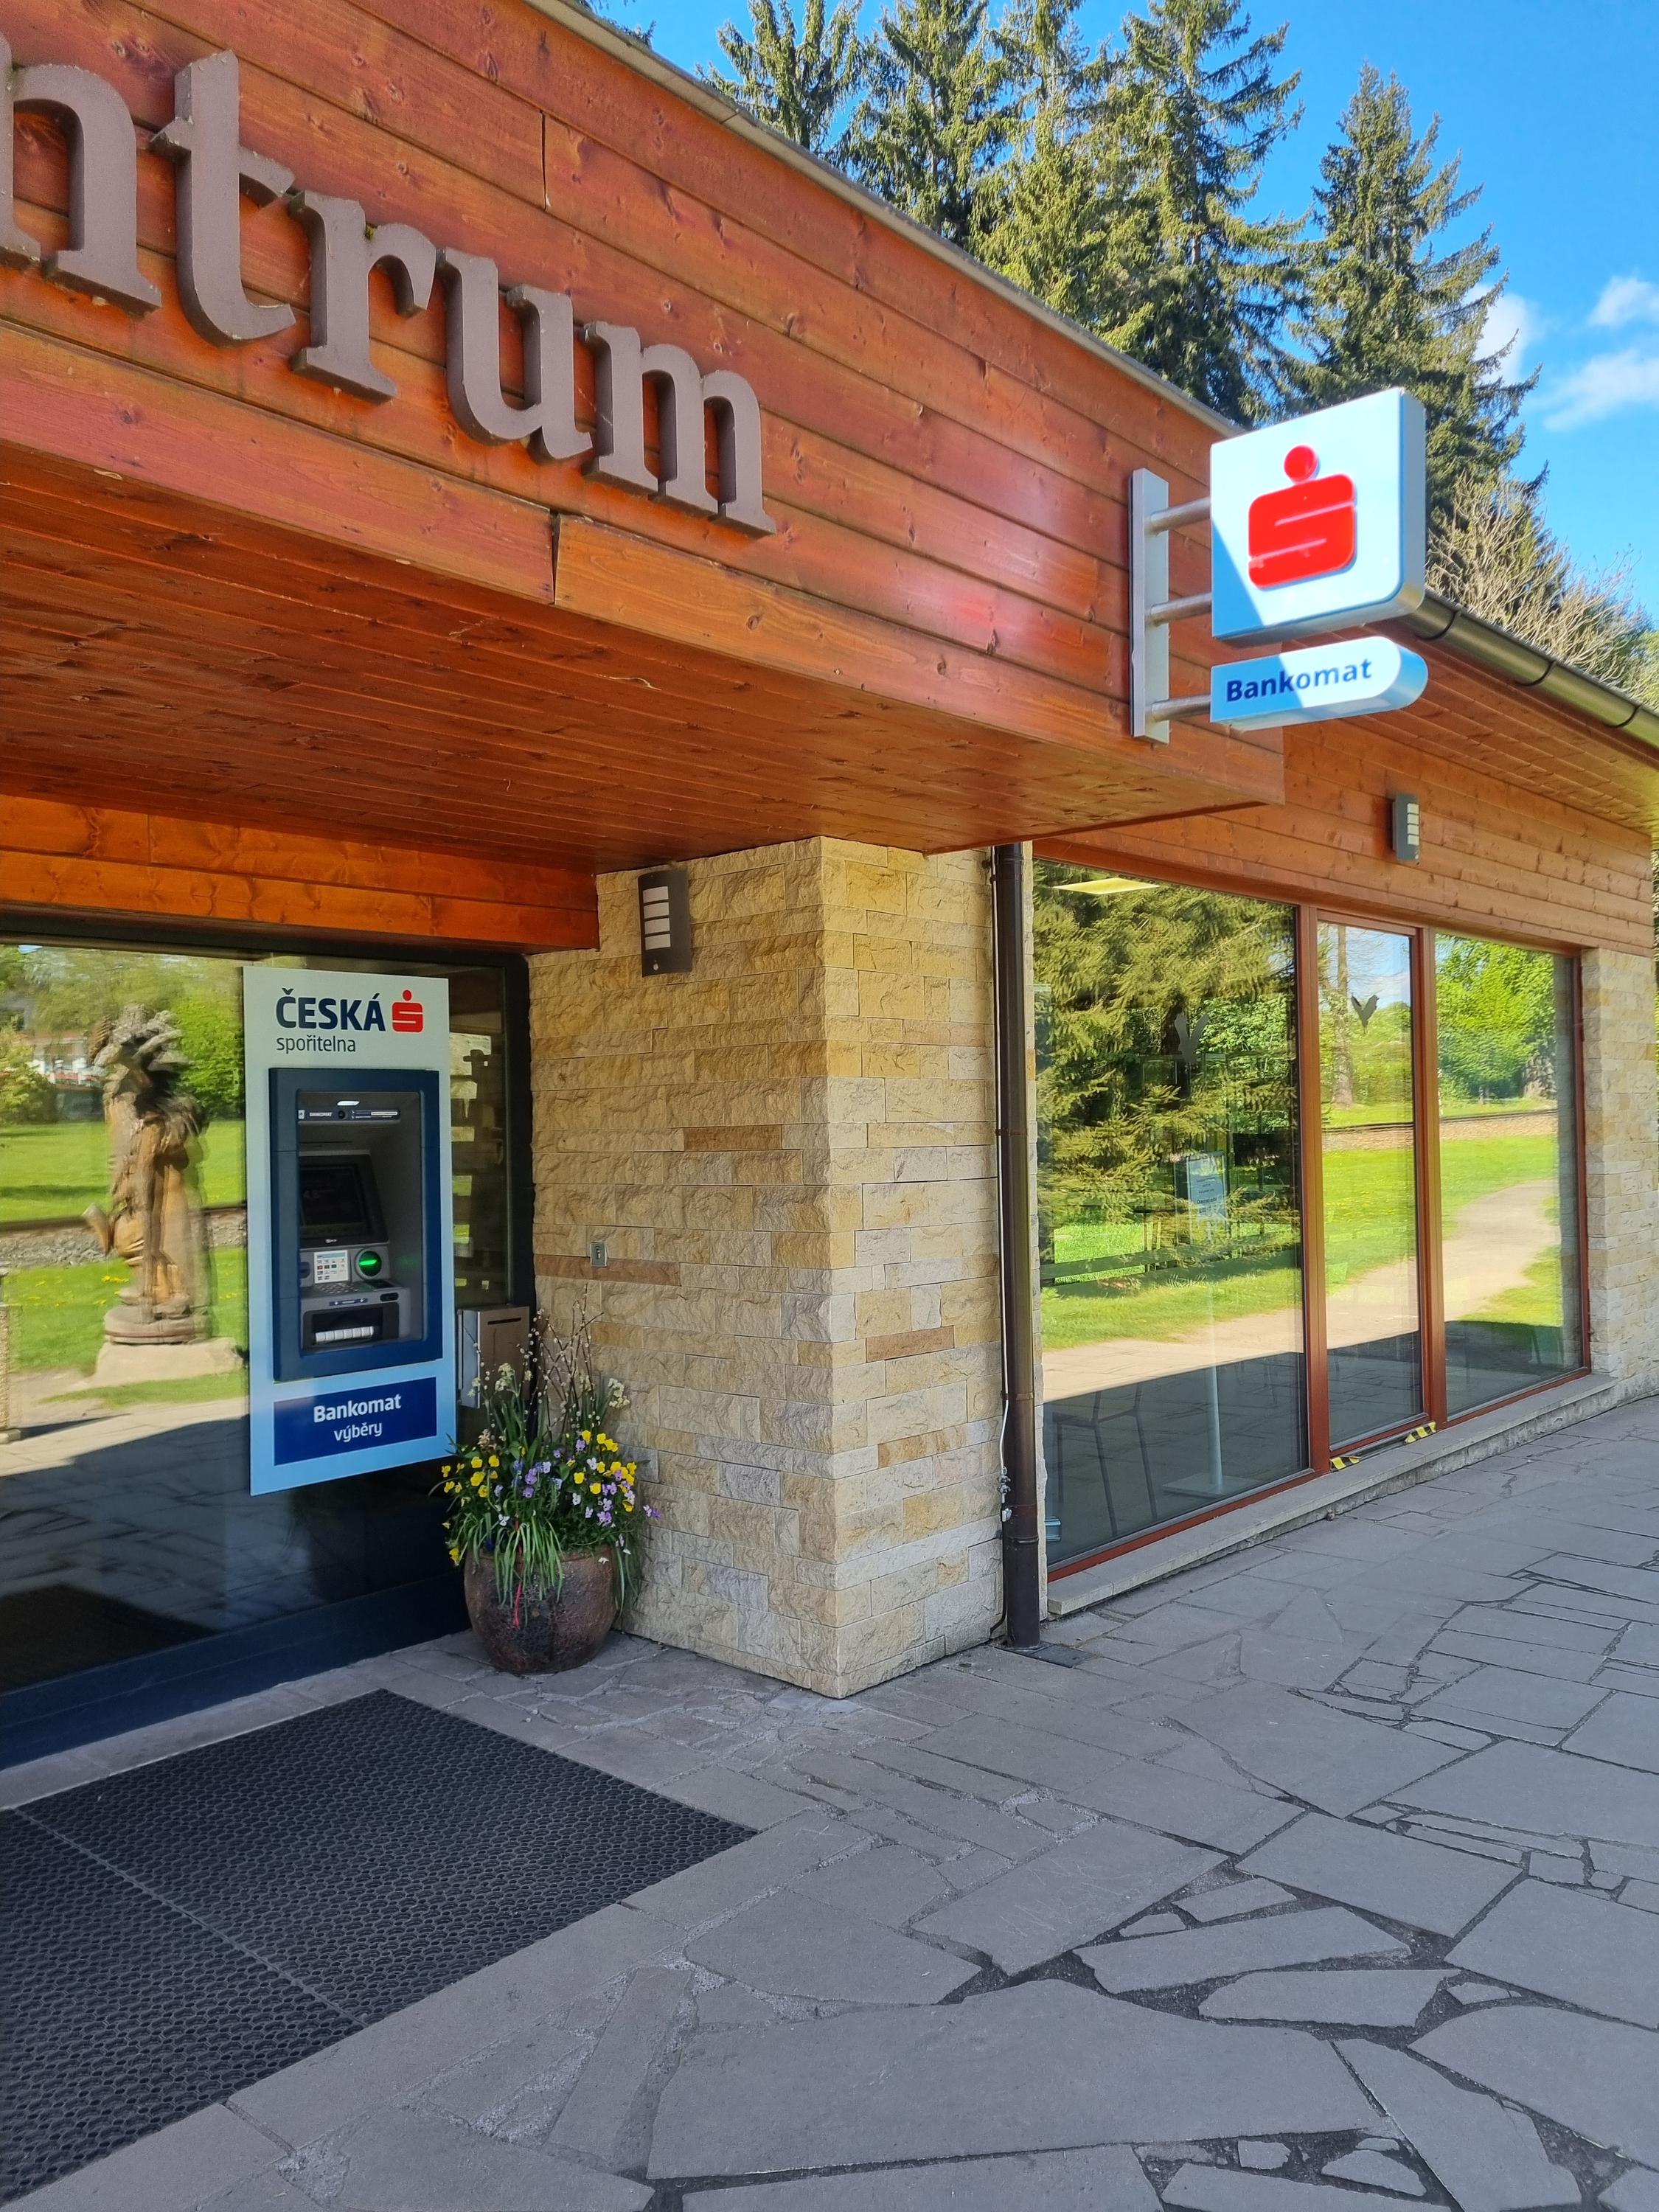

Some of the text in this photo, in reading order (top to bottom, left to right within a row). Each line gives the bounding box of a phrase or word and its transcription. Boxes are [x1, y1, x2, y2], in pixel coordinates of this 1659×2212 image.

[1226, 658, 1372, 702] Bankomat
[276, 987, 386, 1032] ČESKÁ
[276, 1034, 356, 1054] spořitelna
[313, 1394, 402, 1423] Bankomat
[333, 1422, 383, 1443] výběry
